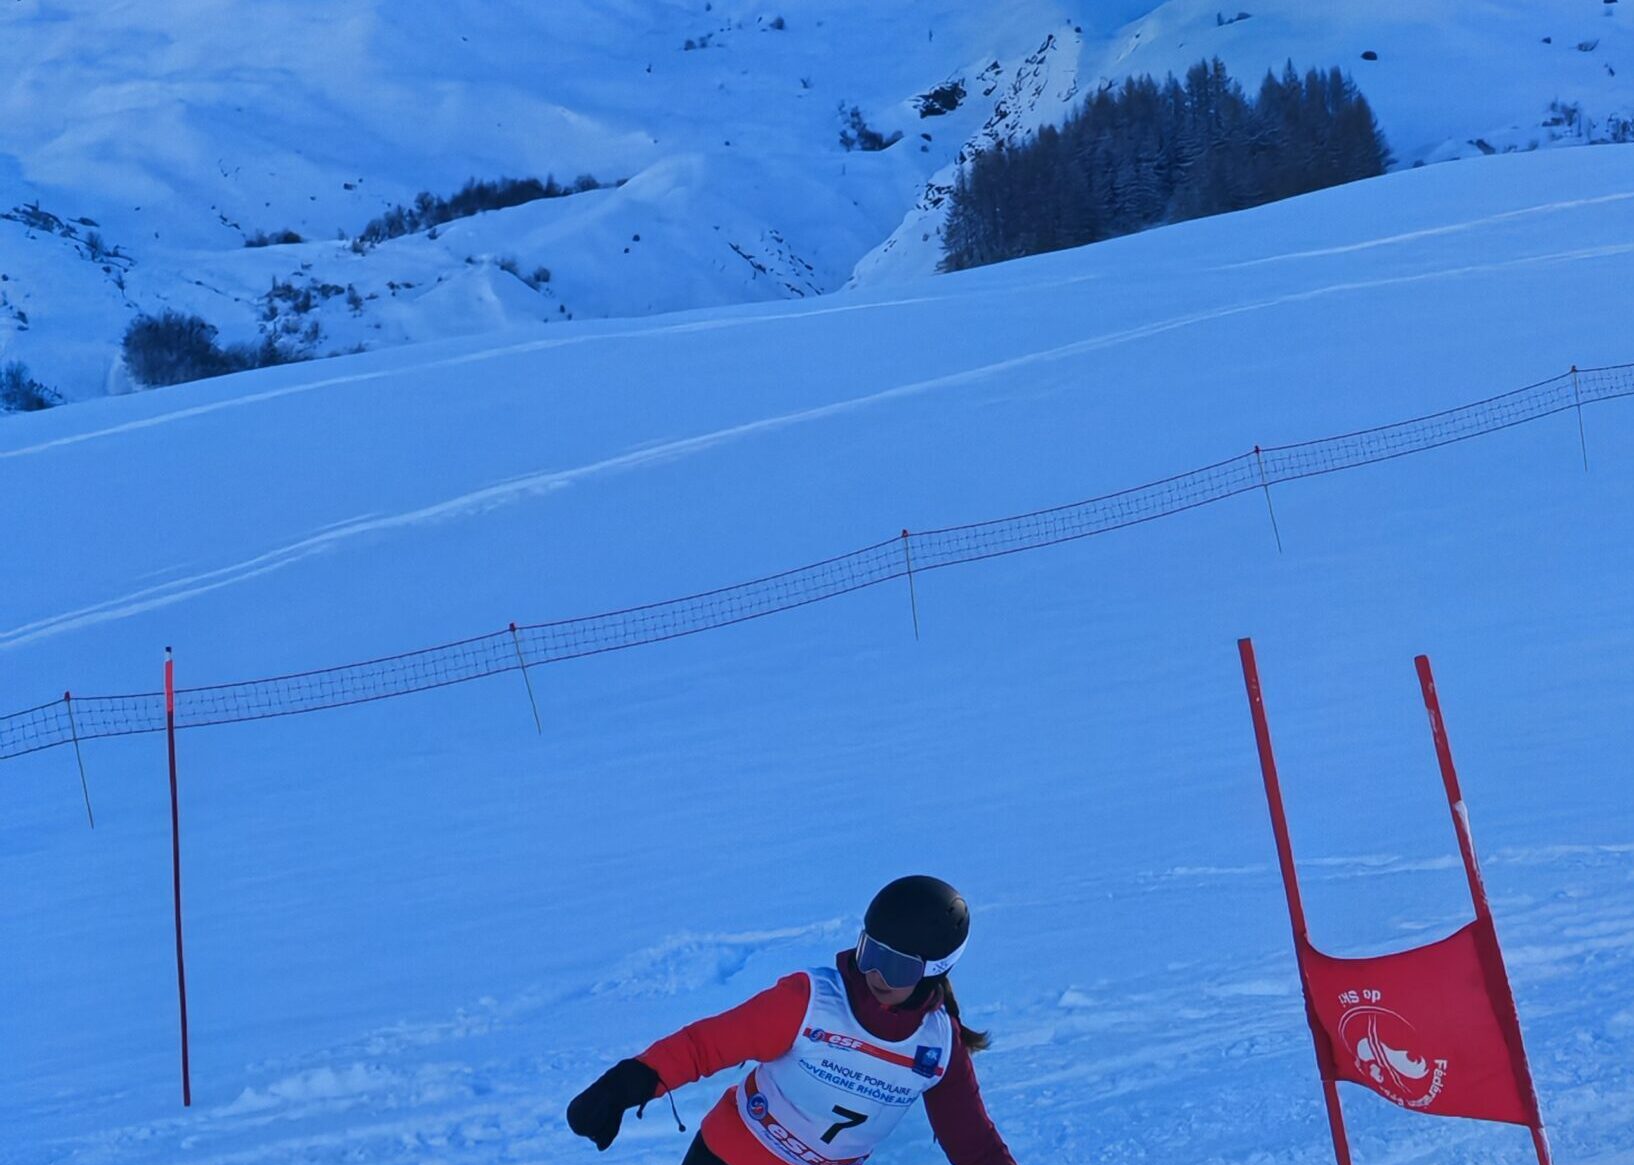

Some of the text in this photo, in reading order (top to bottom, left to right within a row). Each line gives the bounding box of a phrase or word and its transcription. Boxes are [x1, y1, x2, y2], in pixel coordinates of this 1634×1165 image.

[1338, 989, 1360, 1007] Ski
[820, 1059, 863, 1081] BANQUE
[863, 1074, 912, 1096] POPULAIRE
[856, 1084, 896, 1103] RHÔNE
[767, 1123, 824, 1163] esf
[820, 1104, 869, 1145] 7
